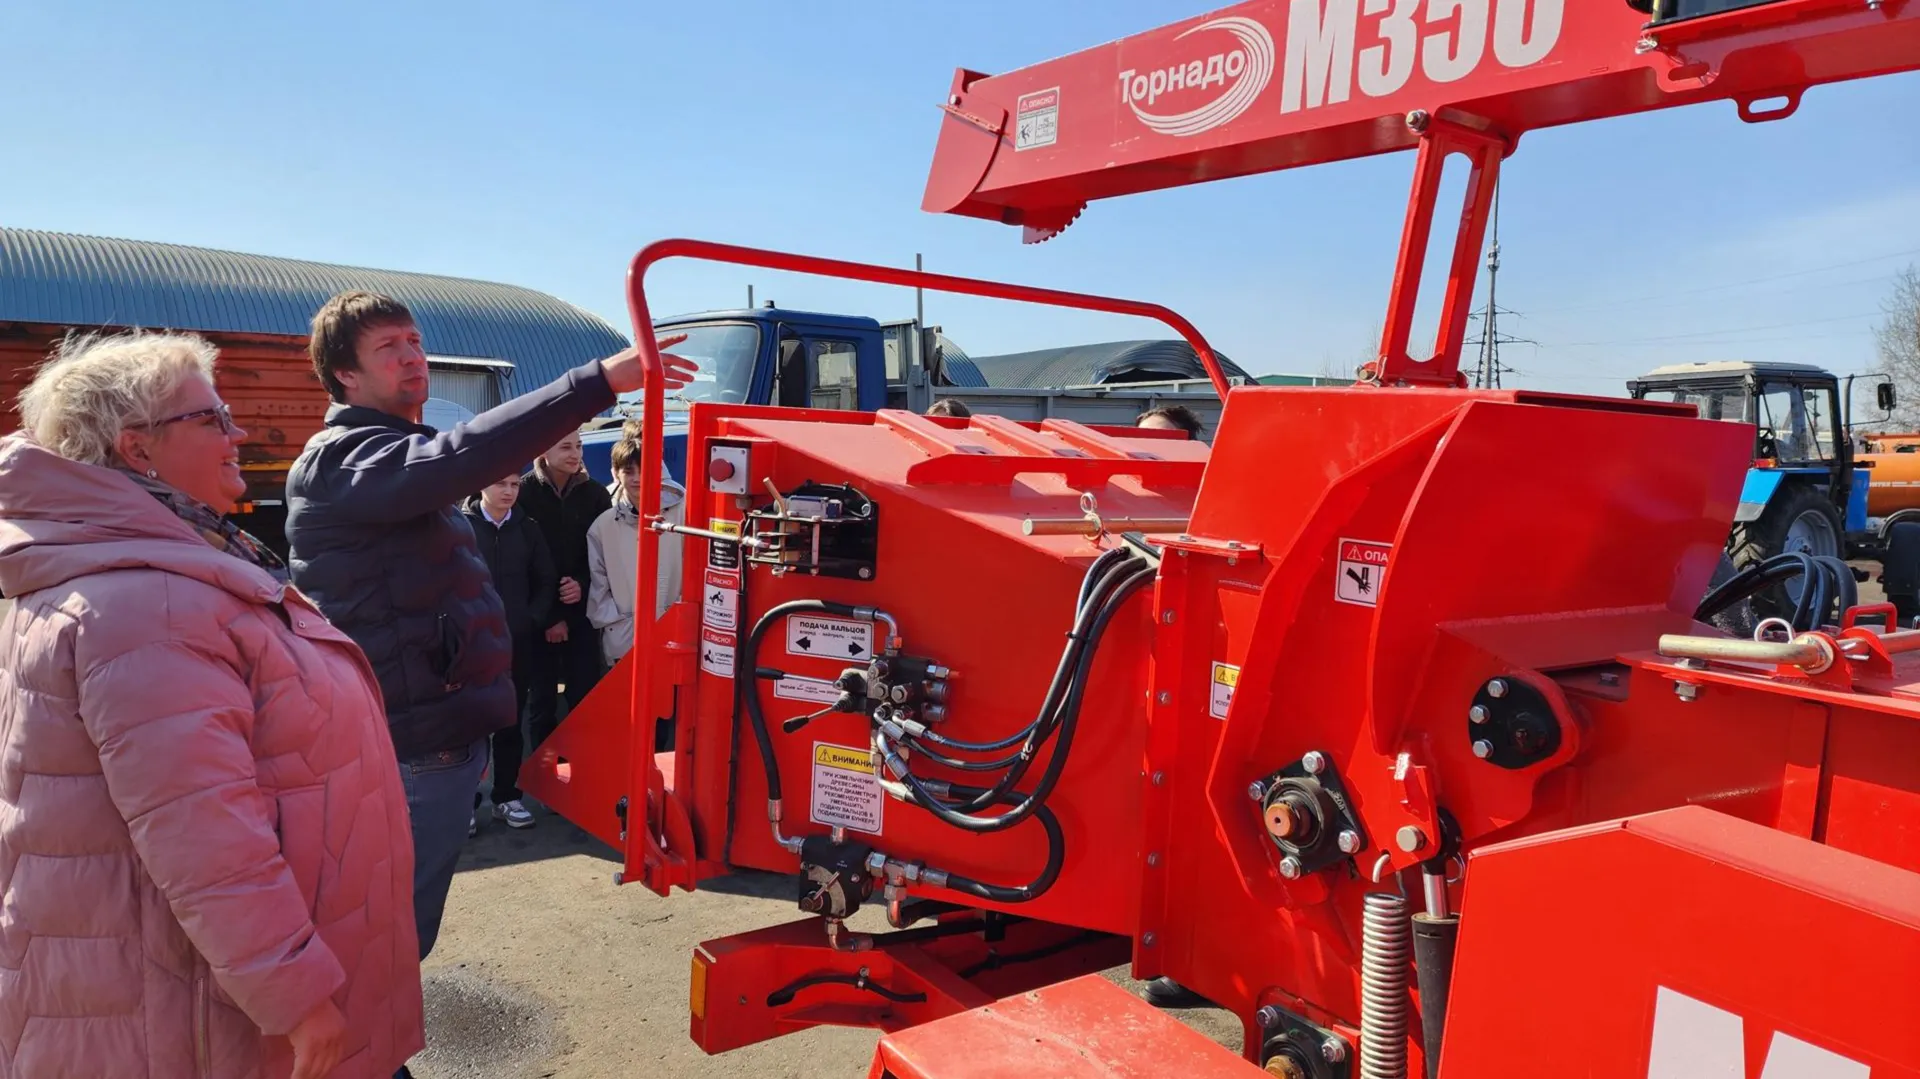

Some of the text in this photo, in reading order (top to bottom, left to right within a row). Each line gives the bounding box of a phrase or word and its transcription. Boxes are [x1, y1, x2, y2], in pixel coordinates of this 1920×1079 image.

[1118, 49, 1246, 106] Торнадо
[799, 621, 866, 634] ПОДАЧА ВАЛЬЦОВ
[830, 780, 865, 790] ДРЕВЕСИНЫ
[834, 774, 874, 785] ИЗМЕЛЬЧЕНИИ
[818, 784, 877, 799] КРУПНЫХ ДИАМЕТРОВ
[824, 791, 870, 804] РЕКОМЕНДУЕТСЯ
[819, 803, 841, 812] ПОДАЧУ
[842, 807, 868, 817] ВАЛЬЦОВ
[830, 799, 864, 810] УМЕНЬШИТЬ
[817, 808, 850, 819] ПОДАЮЩЕМ
